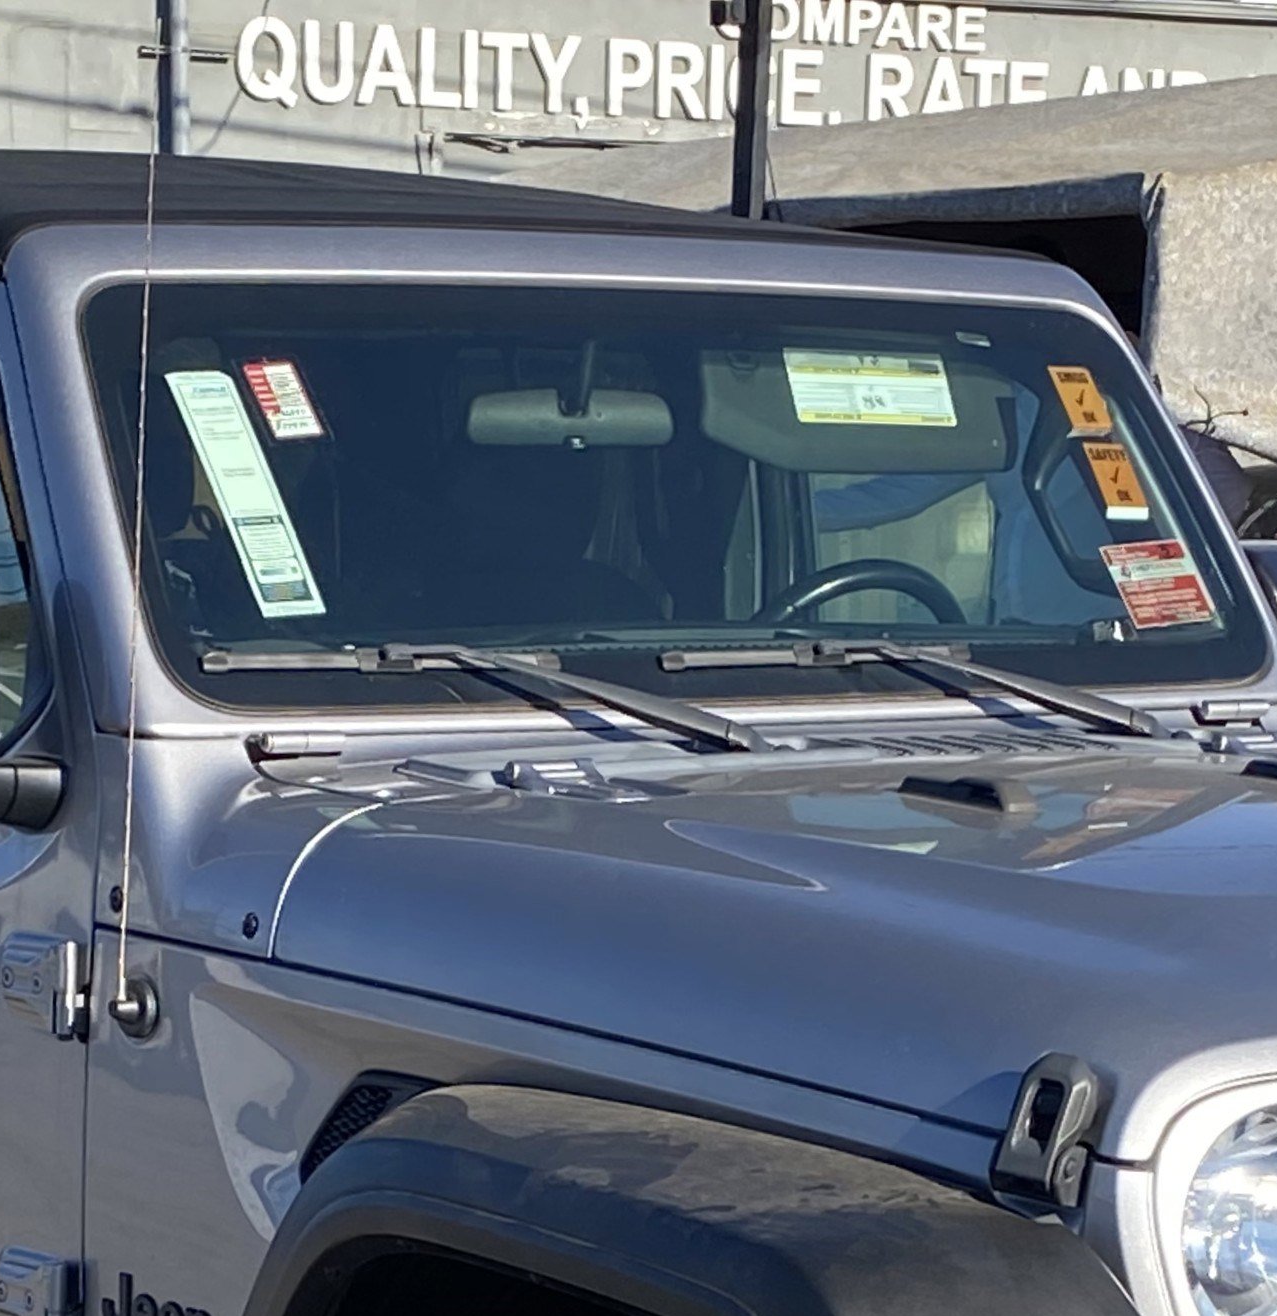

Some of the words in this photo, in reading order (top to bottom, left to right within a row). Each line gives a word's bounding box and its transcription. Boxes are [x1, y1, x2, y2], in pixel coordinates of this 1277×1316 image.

[716, 0, 988, 53] OMPARE
[236, 16, 589, 130] QUALITY,
[865, 53, 1049, 122] RATE
